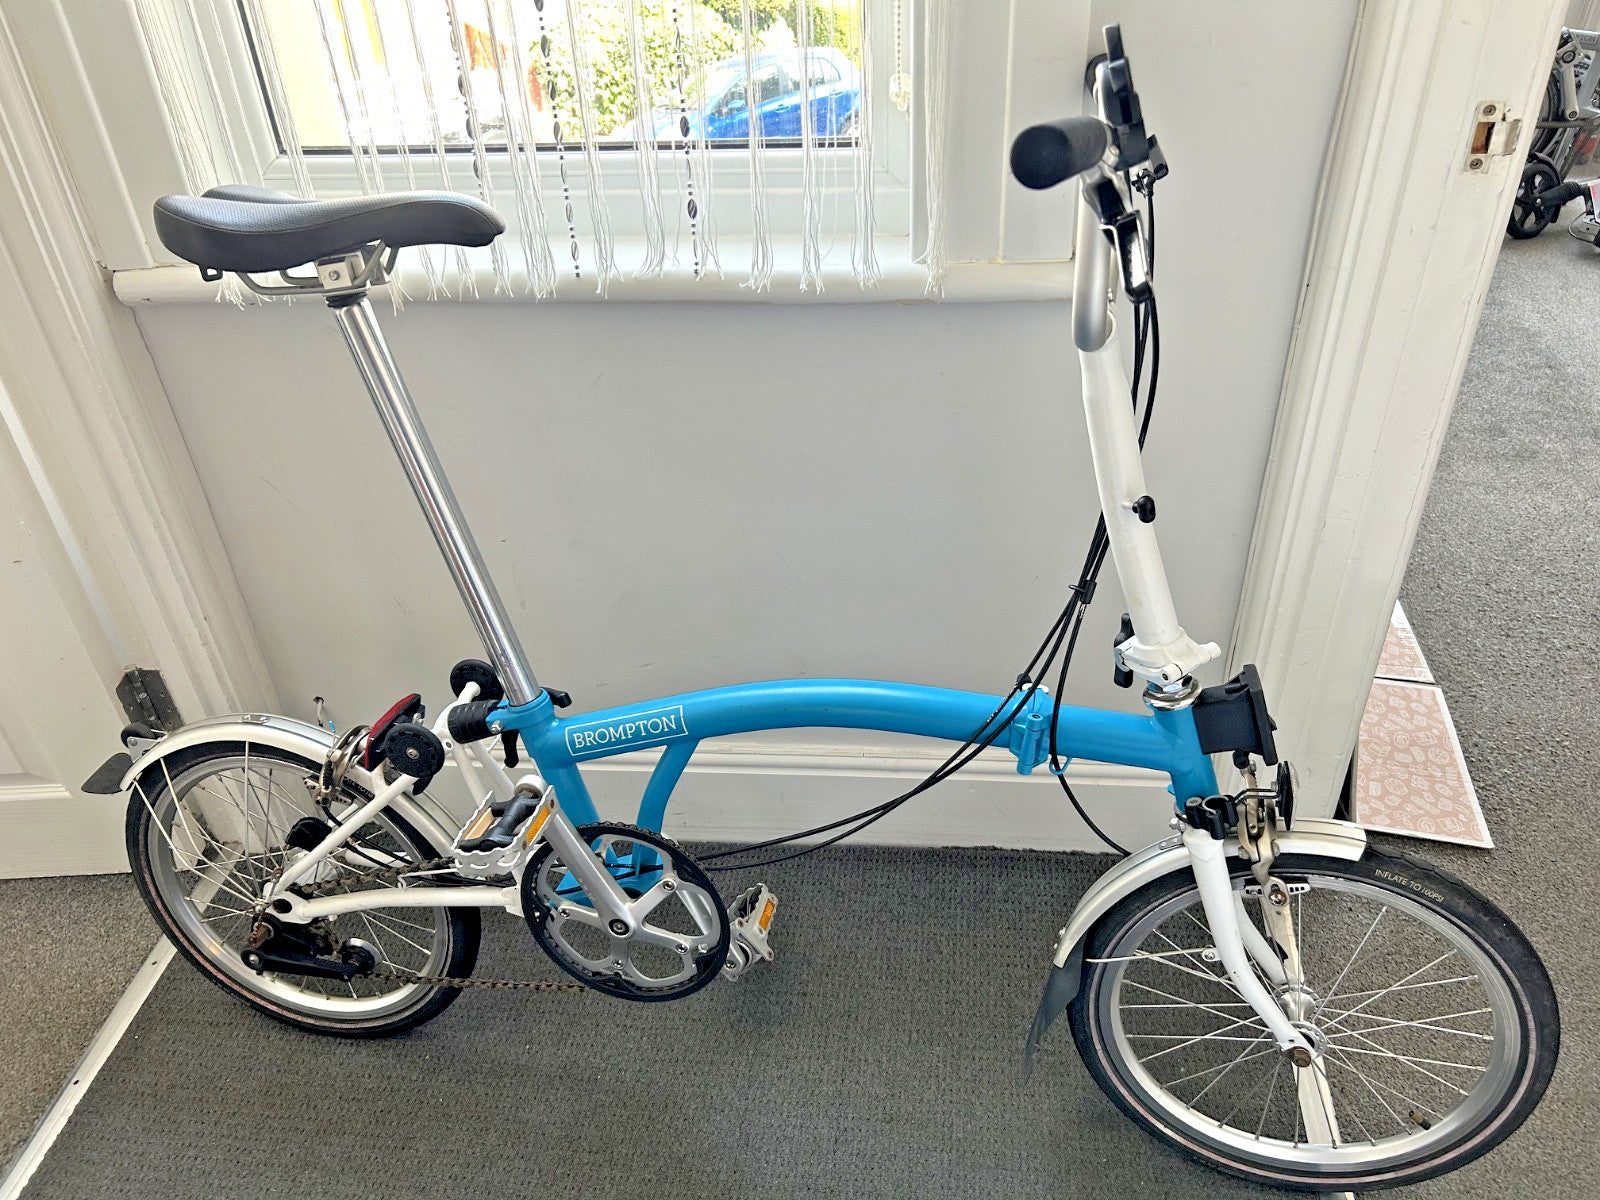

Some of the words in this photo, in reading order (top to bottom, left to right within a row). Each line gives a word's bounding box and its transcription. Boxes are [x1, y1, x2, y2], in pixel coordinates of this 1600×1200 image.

[573, 715, 676, 748] BROMPTON
[1375, 869, 1408, 885] INFLATE
[1410, 881, 1421, 890] TO
[1421, 888, 1444, 902] 100PSI
